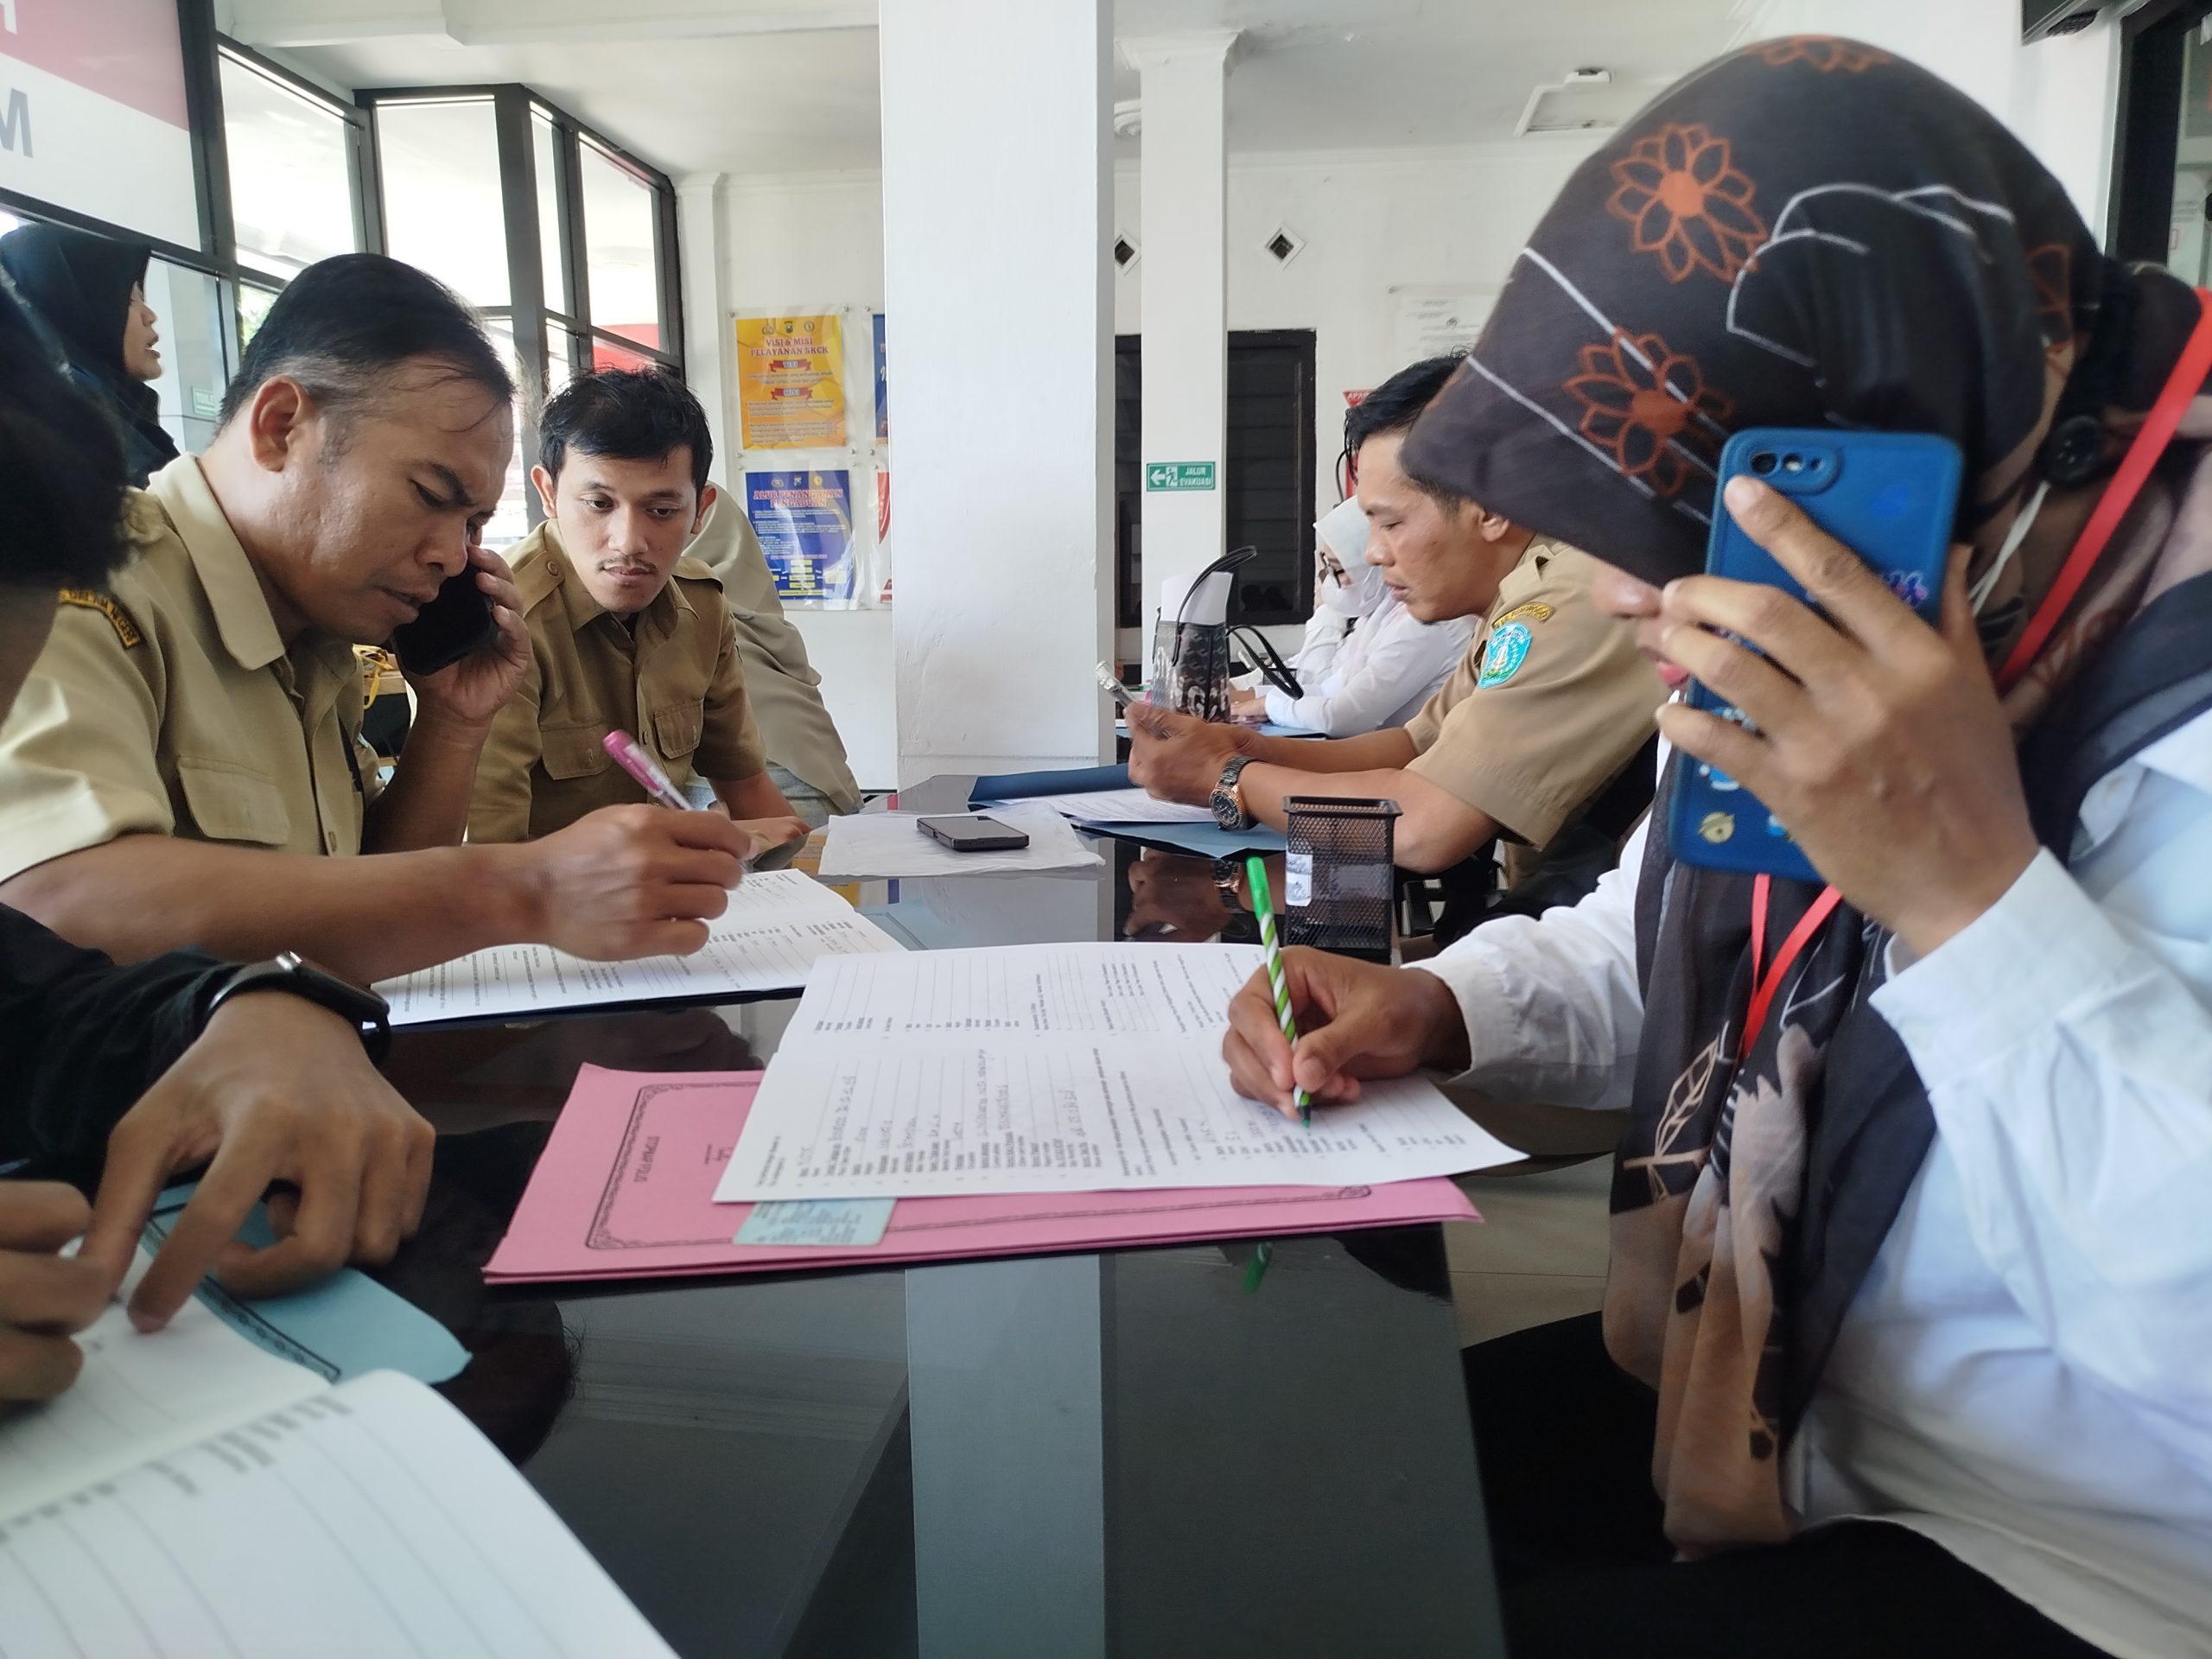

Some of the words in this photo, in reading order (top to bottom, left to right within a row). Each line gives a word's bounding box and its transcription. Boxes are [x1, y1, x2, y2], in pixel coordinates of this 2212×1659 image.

[751, 347, 803, 357] PELAYANAN
[804, 346, 829, 355] SKCK
[1185, 467, 1206, 476] JALUR
[1179, 477, 1211, 486] EVAKUASI
